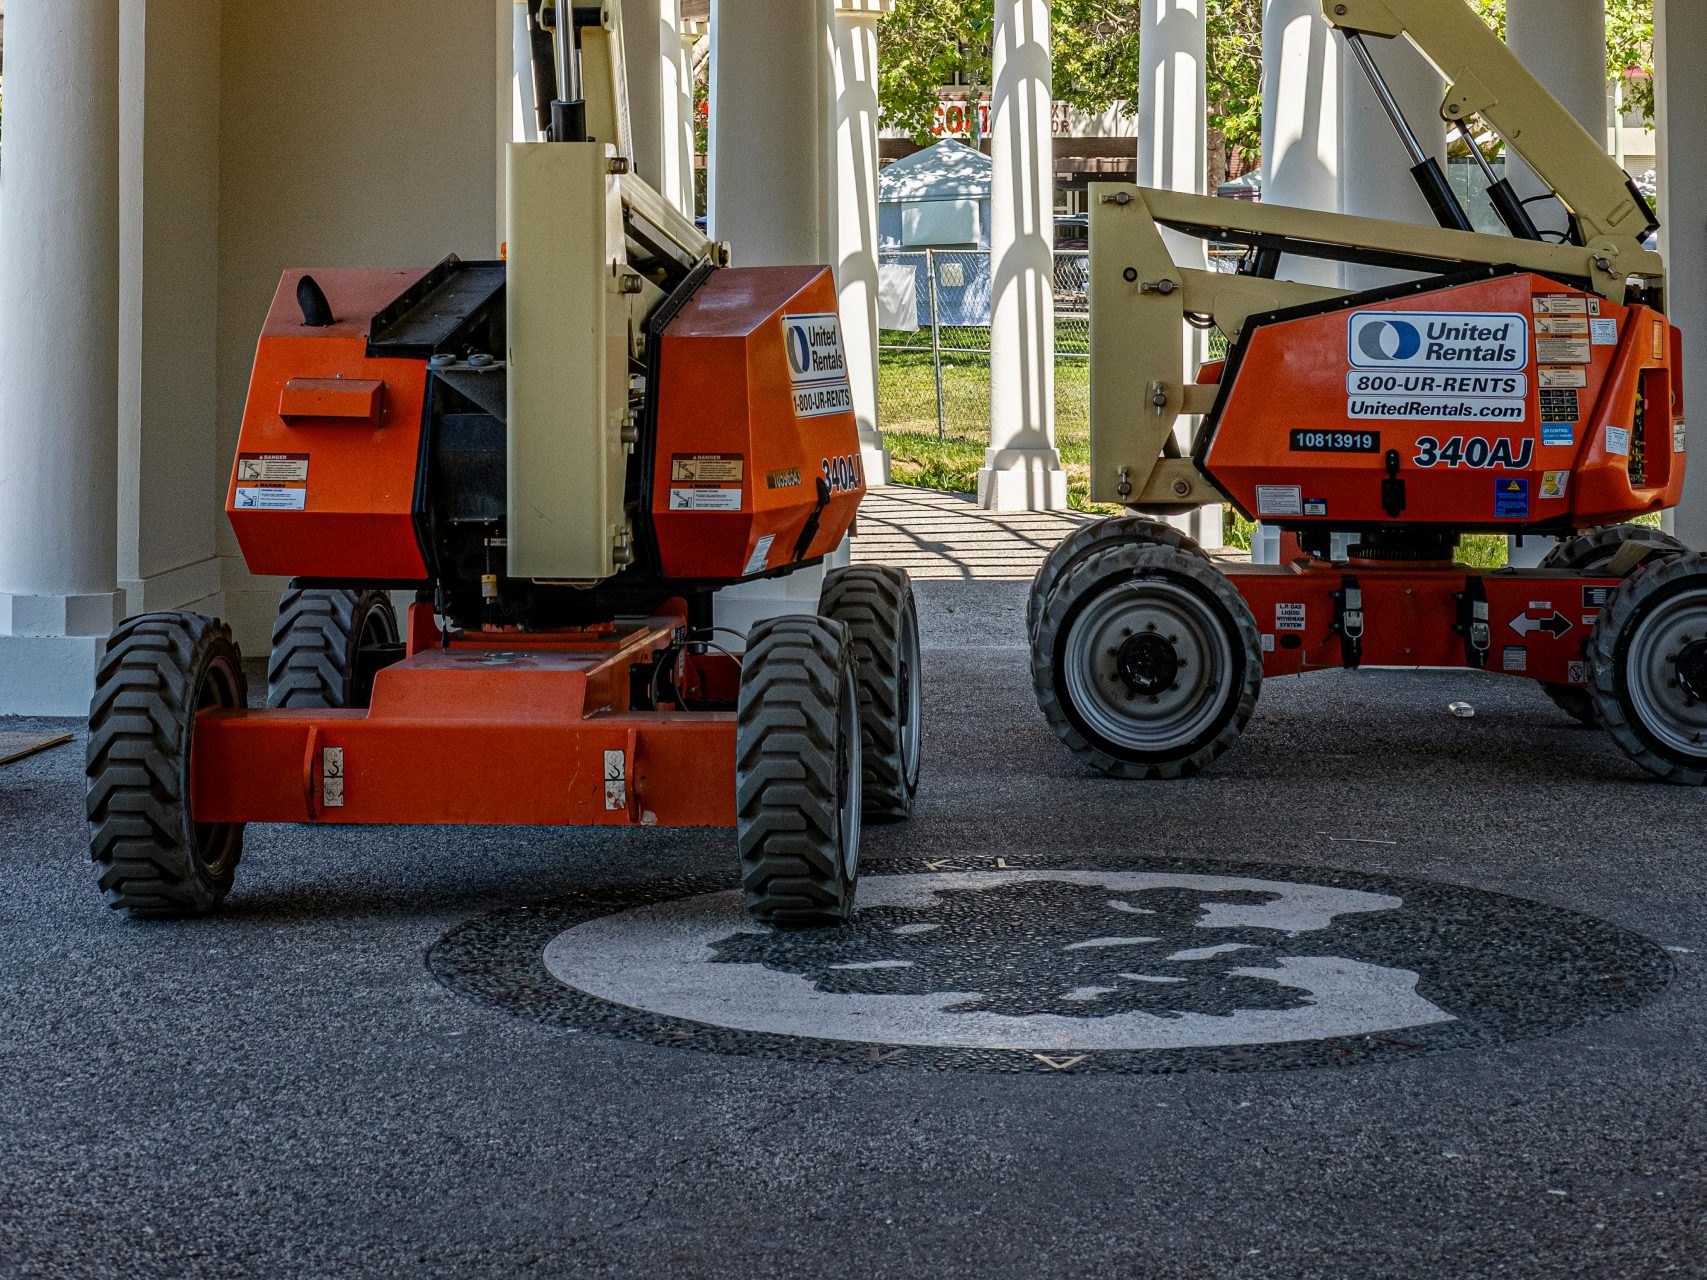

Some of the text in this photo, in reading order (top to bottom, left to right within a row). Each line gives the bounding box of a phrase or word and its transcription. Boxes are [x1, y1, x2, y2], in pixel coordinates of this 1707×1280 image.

[808, 325, 837, 348] United
[1426, 322, 1510, 342] United
[811, 348, 844, 373] Rentals
[1425, 342, 1517, 363] Rentals
[1356, 376, 1517, 394] 800-UR-RENTS
[792, 387, 850, 413] 1-800-UR-RENTS
[1350, 400, 1523, 419] UnitedRentals.com
[1295, 432, 1373, 450] 10813919
[1412, 435, 1535, 470] 340AJ
[821, 453, 863, 496] 340AJ
